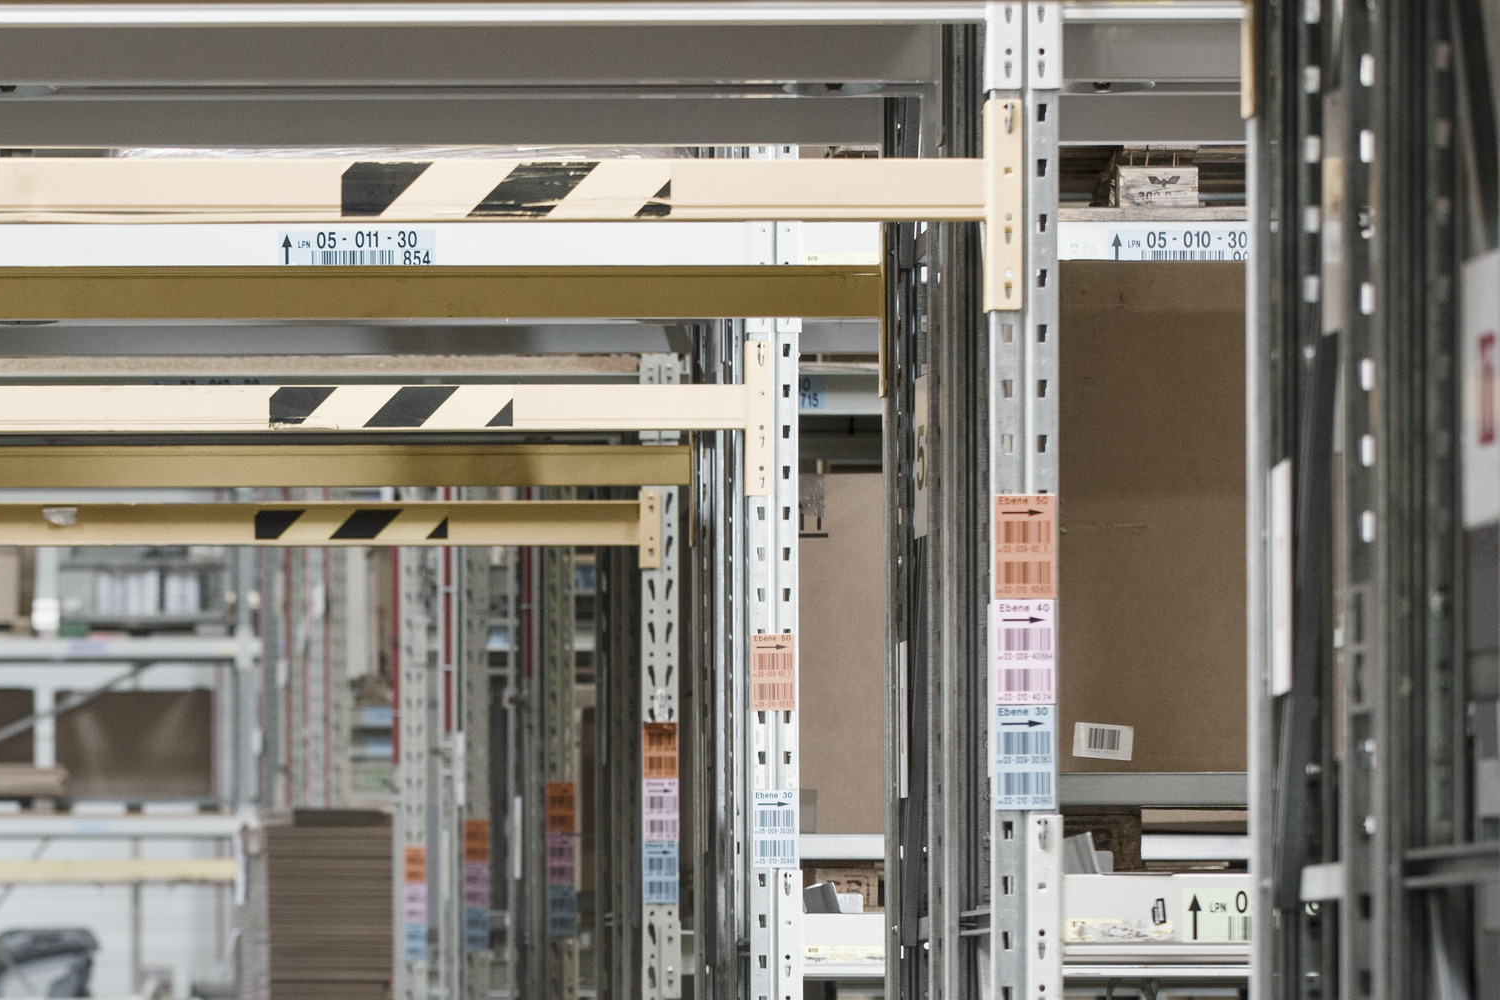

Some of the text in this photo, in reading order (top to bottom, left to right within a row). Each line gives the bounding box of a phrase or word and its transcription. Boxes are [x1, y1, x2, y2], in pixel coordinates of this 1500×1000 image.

[316, 232, 336, 249] 05
[355, 231, 379, 248] 011
[397, 230, 418, 248] 30
[1128, 240, 1141, 248] LPN
[1146, 231, 1167, 248] 05
[1183, 230, 1211, 248] 010
[1228, 231, 1247, 248] 30
[403, 250, 431, 266] 854
[998, 496, 1028, 505] Ebene
[1000, 603, 1050, 612] Ebene 40
[997, 707, 1048, 716] Ebene 30
[1209, 890, 1248, 913] LPN 0
